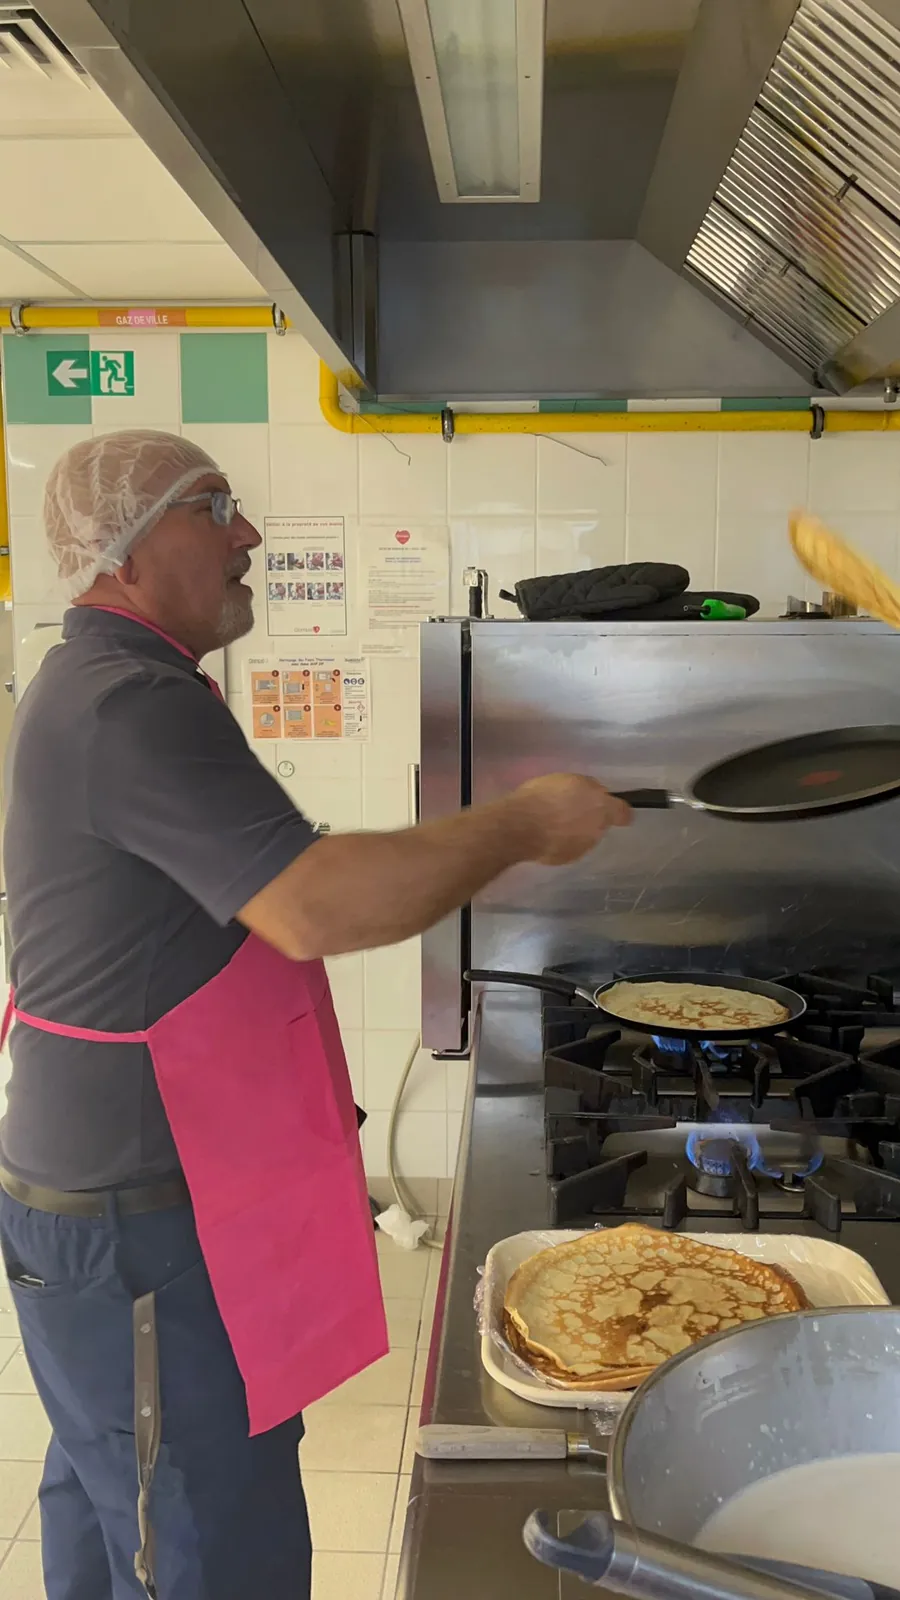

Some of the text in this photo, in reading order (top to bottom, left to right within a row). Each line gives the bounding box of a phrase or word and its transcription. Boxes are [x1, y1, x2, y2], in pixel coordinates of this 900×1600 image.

[116, 315, 168, 325] GAZ DE VILLE
